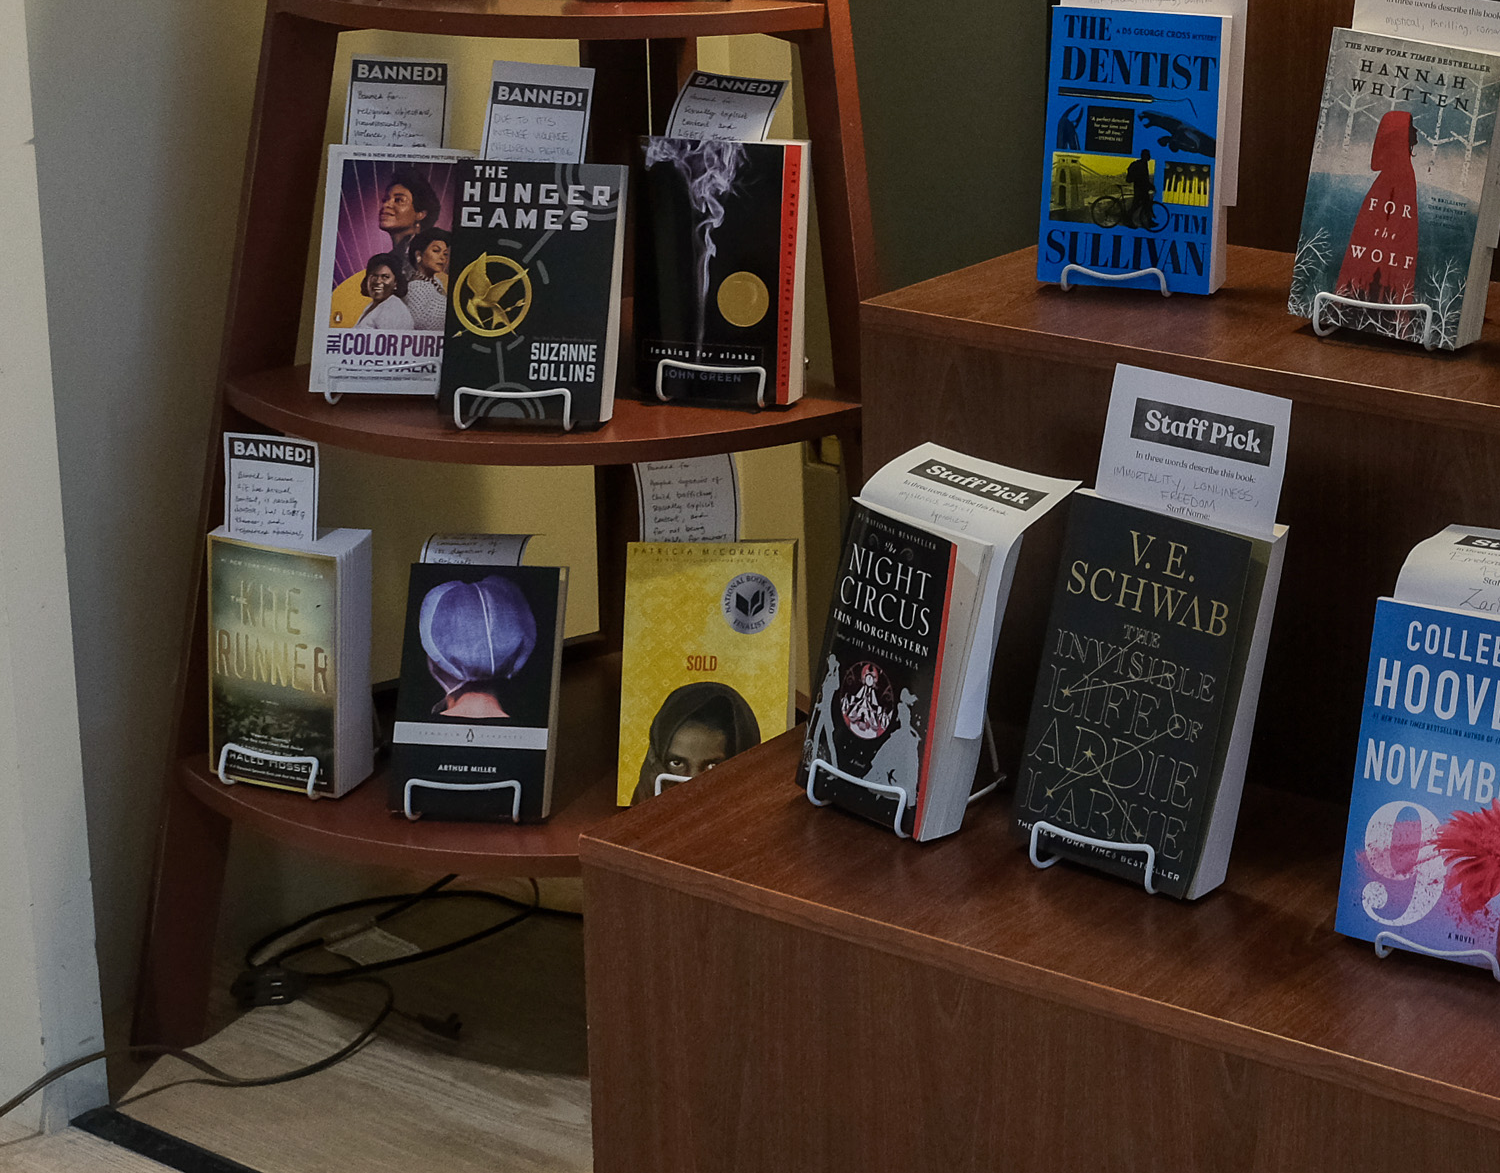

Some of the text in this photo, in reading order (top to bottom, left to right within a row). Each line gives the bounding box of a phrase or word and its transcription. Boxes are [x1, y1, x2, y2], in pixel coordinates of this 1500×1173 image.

[1064, 13, 1113, 42] THE
[356, 63, 443, 81] BANNED!
[1060, 44, 1218, 92] DENTIST
[1360, 58, 1467, 91] HANNAH
[496, 86, 583, 107] BANNED!
[694, 75, 779, 95] BANNED!
[1351, 78, 1470, 112] WHITTEN
[474, 166, 509, 179] THE
[461, 180, 612, 207] HUNGER
[1368, 197, 1413, 219] FOR
[460, 206, 590, 232] GAMES
[1170, 212, 1208, 236] TIM
[1373, 227, 1398, 241] the
[1044, 228, 1207, 277] SULLIVAN
[1350, 244, 1414, 270] WOLF
[342, 332, 399, 357] COLOR
[530, 342, 598, 363] SUZANNE
[528, 364, 596, 383] COLLINS
[1143, 408, 1261, 454] Staff Pick
[233, 440, 312, 464] BANNED!
[925, 463, 1030, 508] Staff Pick
[1160, 489, 1217, 511] FREEDOM
[633, 546, 693, 556] PATRICIA
[1129, 529, 1196, 584] V. E.
[848, 541, 933, 602] NIGHT
[239, 580, 301, 635] KITE
[724, 577, 745, 614] NATIONAL
[745, 575, 768, 587] BOOK
[839, 574, 931, 638] CIRCUS
[1066, 559, 1230, 639] SCHWAB
[732, 618, 766, 630] FINALIST
[832, 607, 930, 658] ERIN MORGENSTERN
[216, 629, 329, 695] RUNNER
[686, 655, 718, 672] SOLD
[1052, 627, 1218, 704] INVISIBLE
[1042, 663, 1163, 741] LIFE
[1027, 716, 1200, 813] ADDIE
[1019, 766, 1189, 864] LARUE
[1362, 800, 1446, 927] 9
